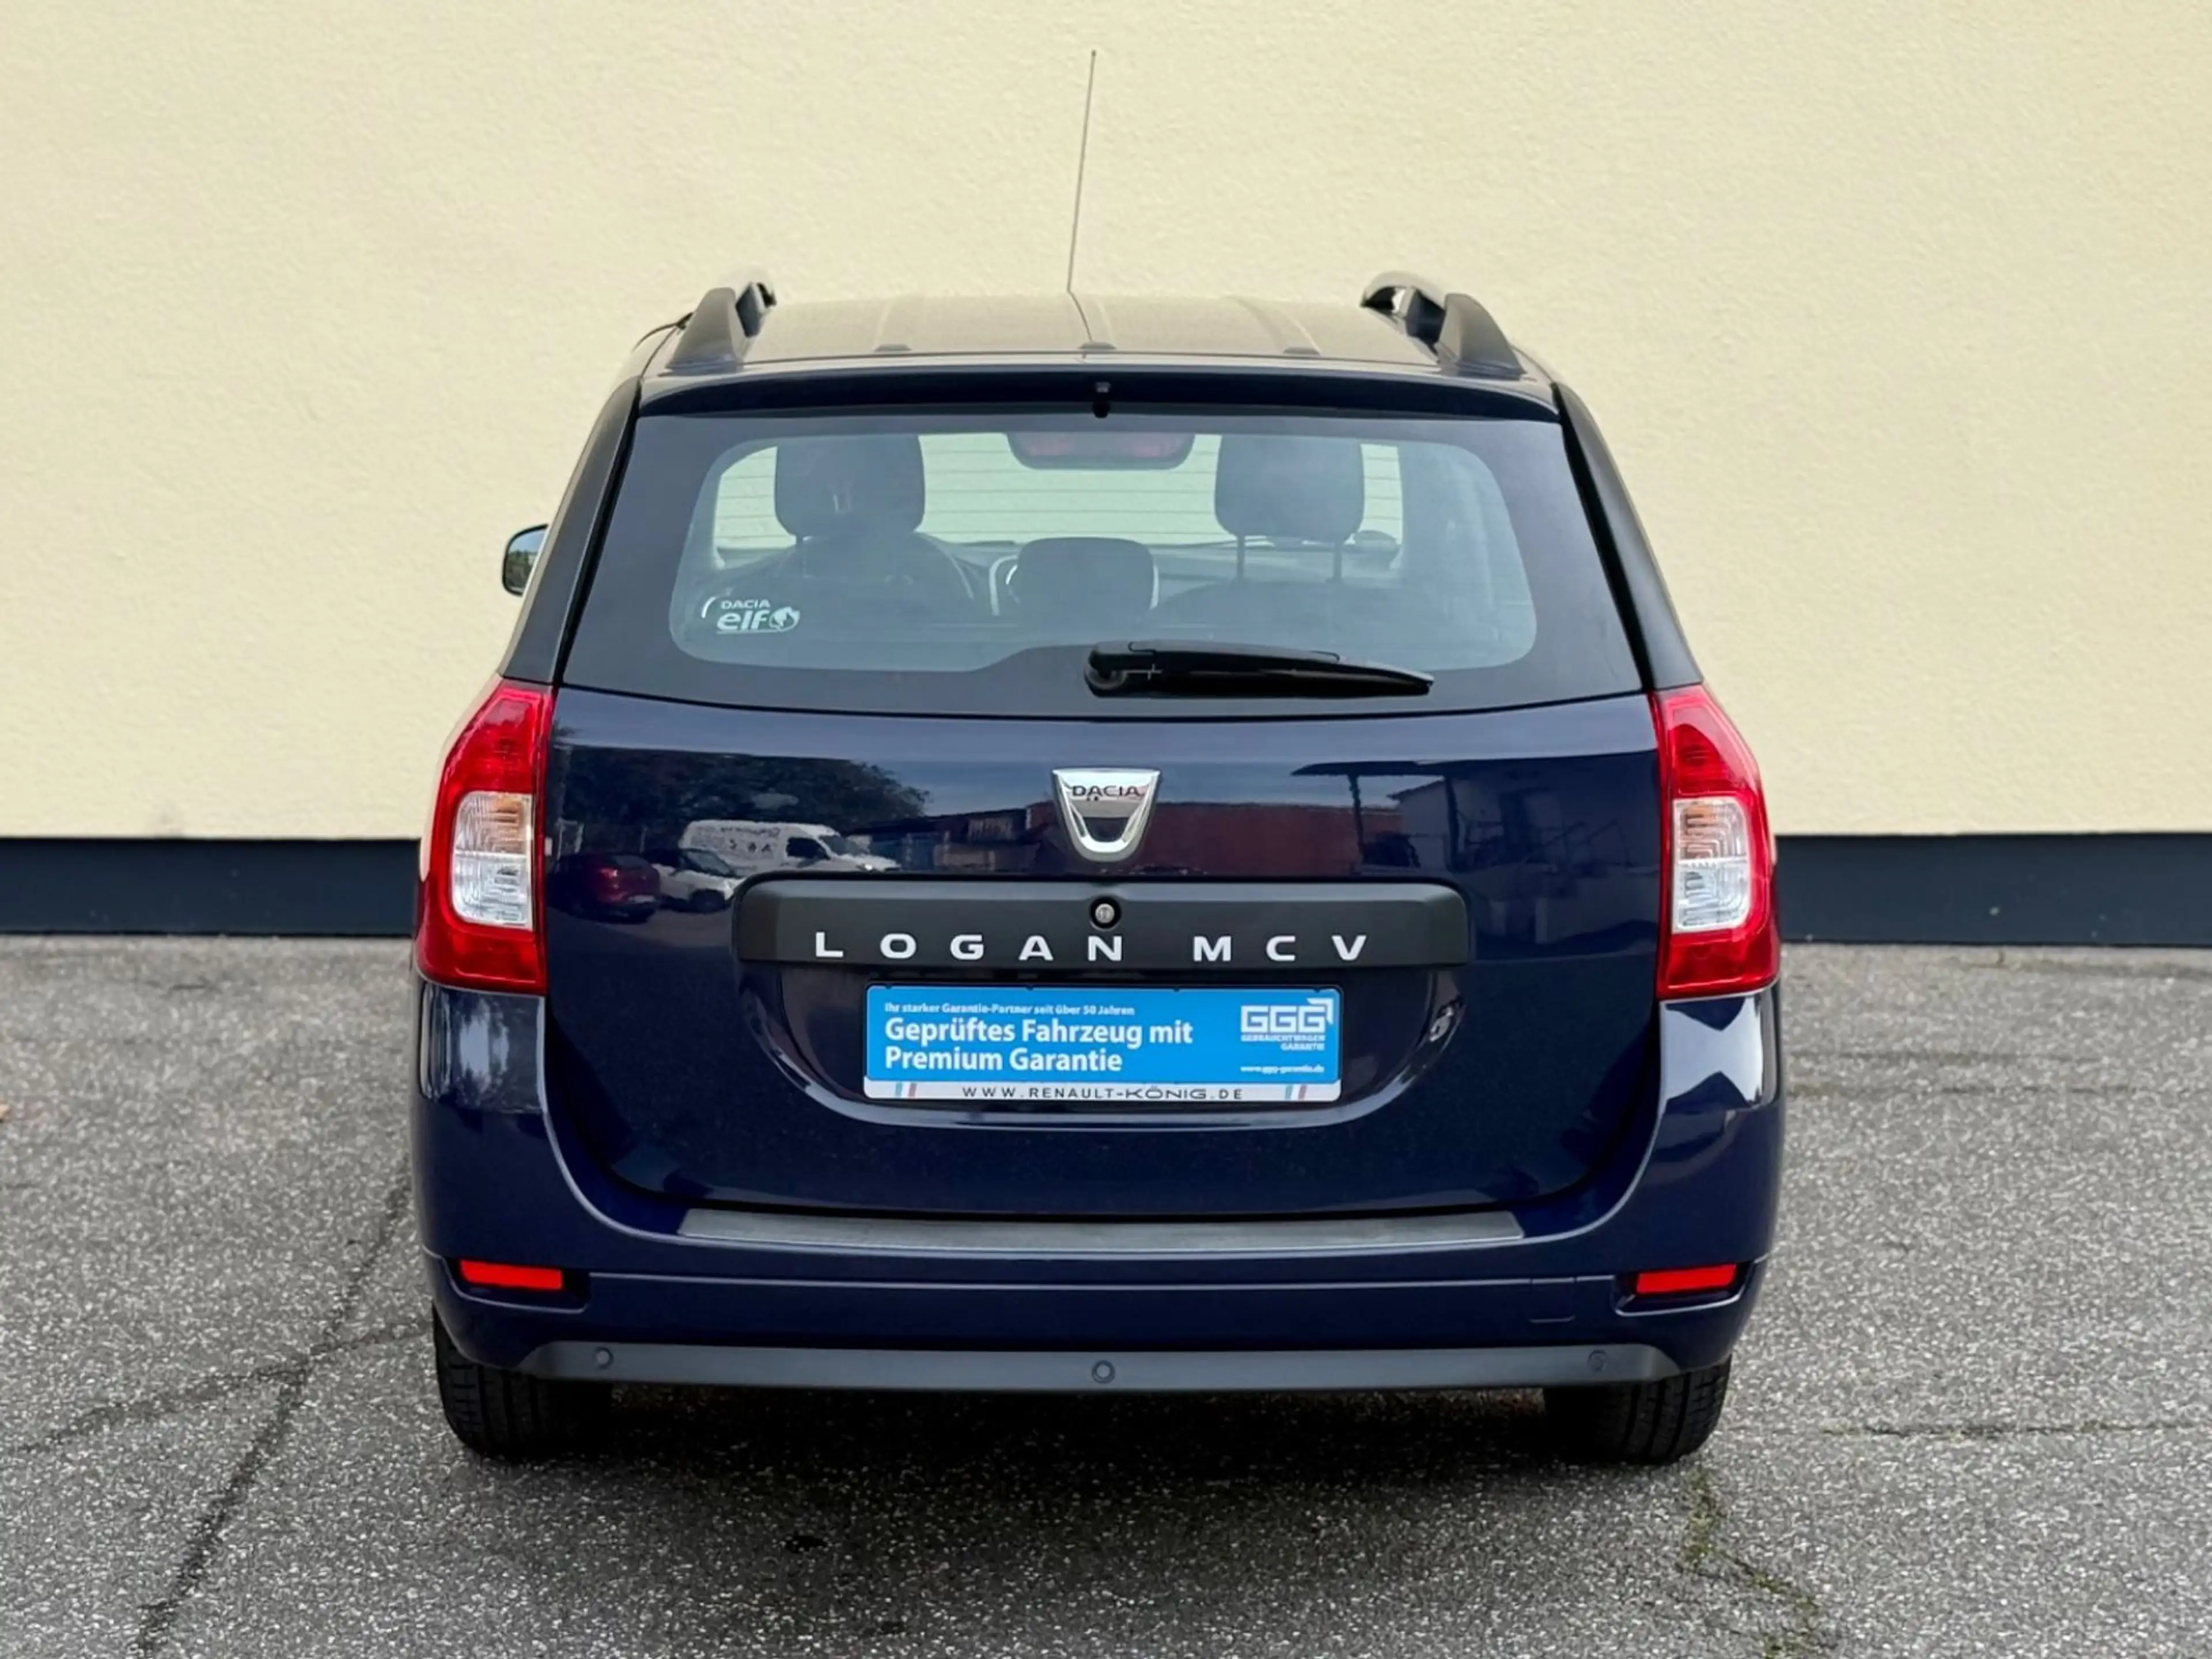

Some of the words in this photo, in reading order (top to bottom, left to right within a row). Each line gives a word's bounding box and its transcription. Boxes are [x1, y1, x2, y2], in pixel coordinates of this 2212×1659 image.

[721, 599, 771, 609] DACIA
[717, 609, 770, 630] elf
[1072, 785, 1141, 797] DACIA
[815, 931, 1122, 961] LOGAN
[1192, 935, 1367, 961] MCV
[884, 1002, 899, 1012] Ihr
[902, 1002, 940, 1013] starker
[942, 1002, 1033, 1014] Garantie-Partner
[1034, 1005, 1054, 1014] seit
[1055, 1005, 1080, 1014] über
[1083, 1005, 1096, 1014] 50
[1097, 1005, 1135, 1015] Jahren
[1241, 1005, 1325, 1033] GGG
[885, 1017, 1016, 1047] Geprüftes
[1022, 1018, 1142, 1050] Fahrzeug
[1150, 1020, 1194, 1044] mit
[885, 1046, 1003, 1071] Premium
[1009, 1047, 1123, 1072] Garantie
[962, 1086, 1243, 1100] WWW.RENAULT-KÖNIG.DE
